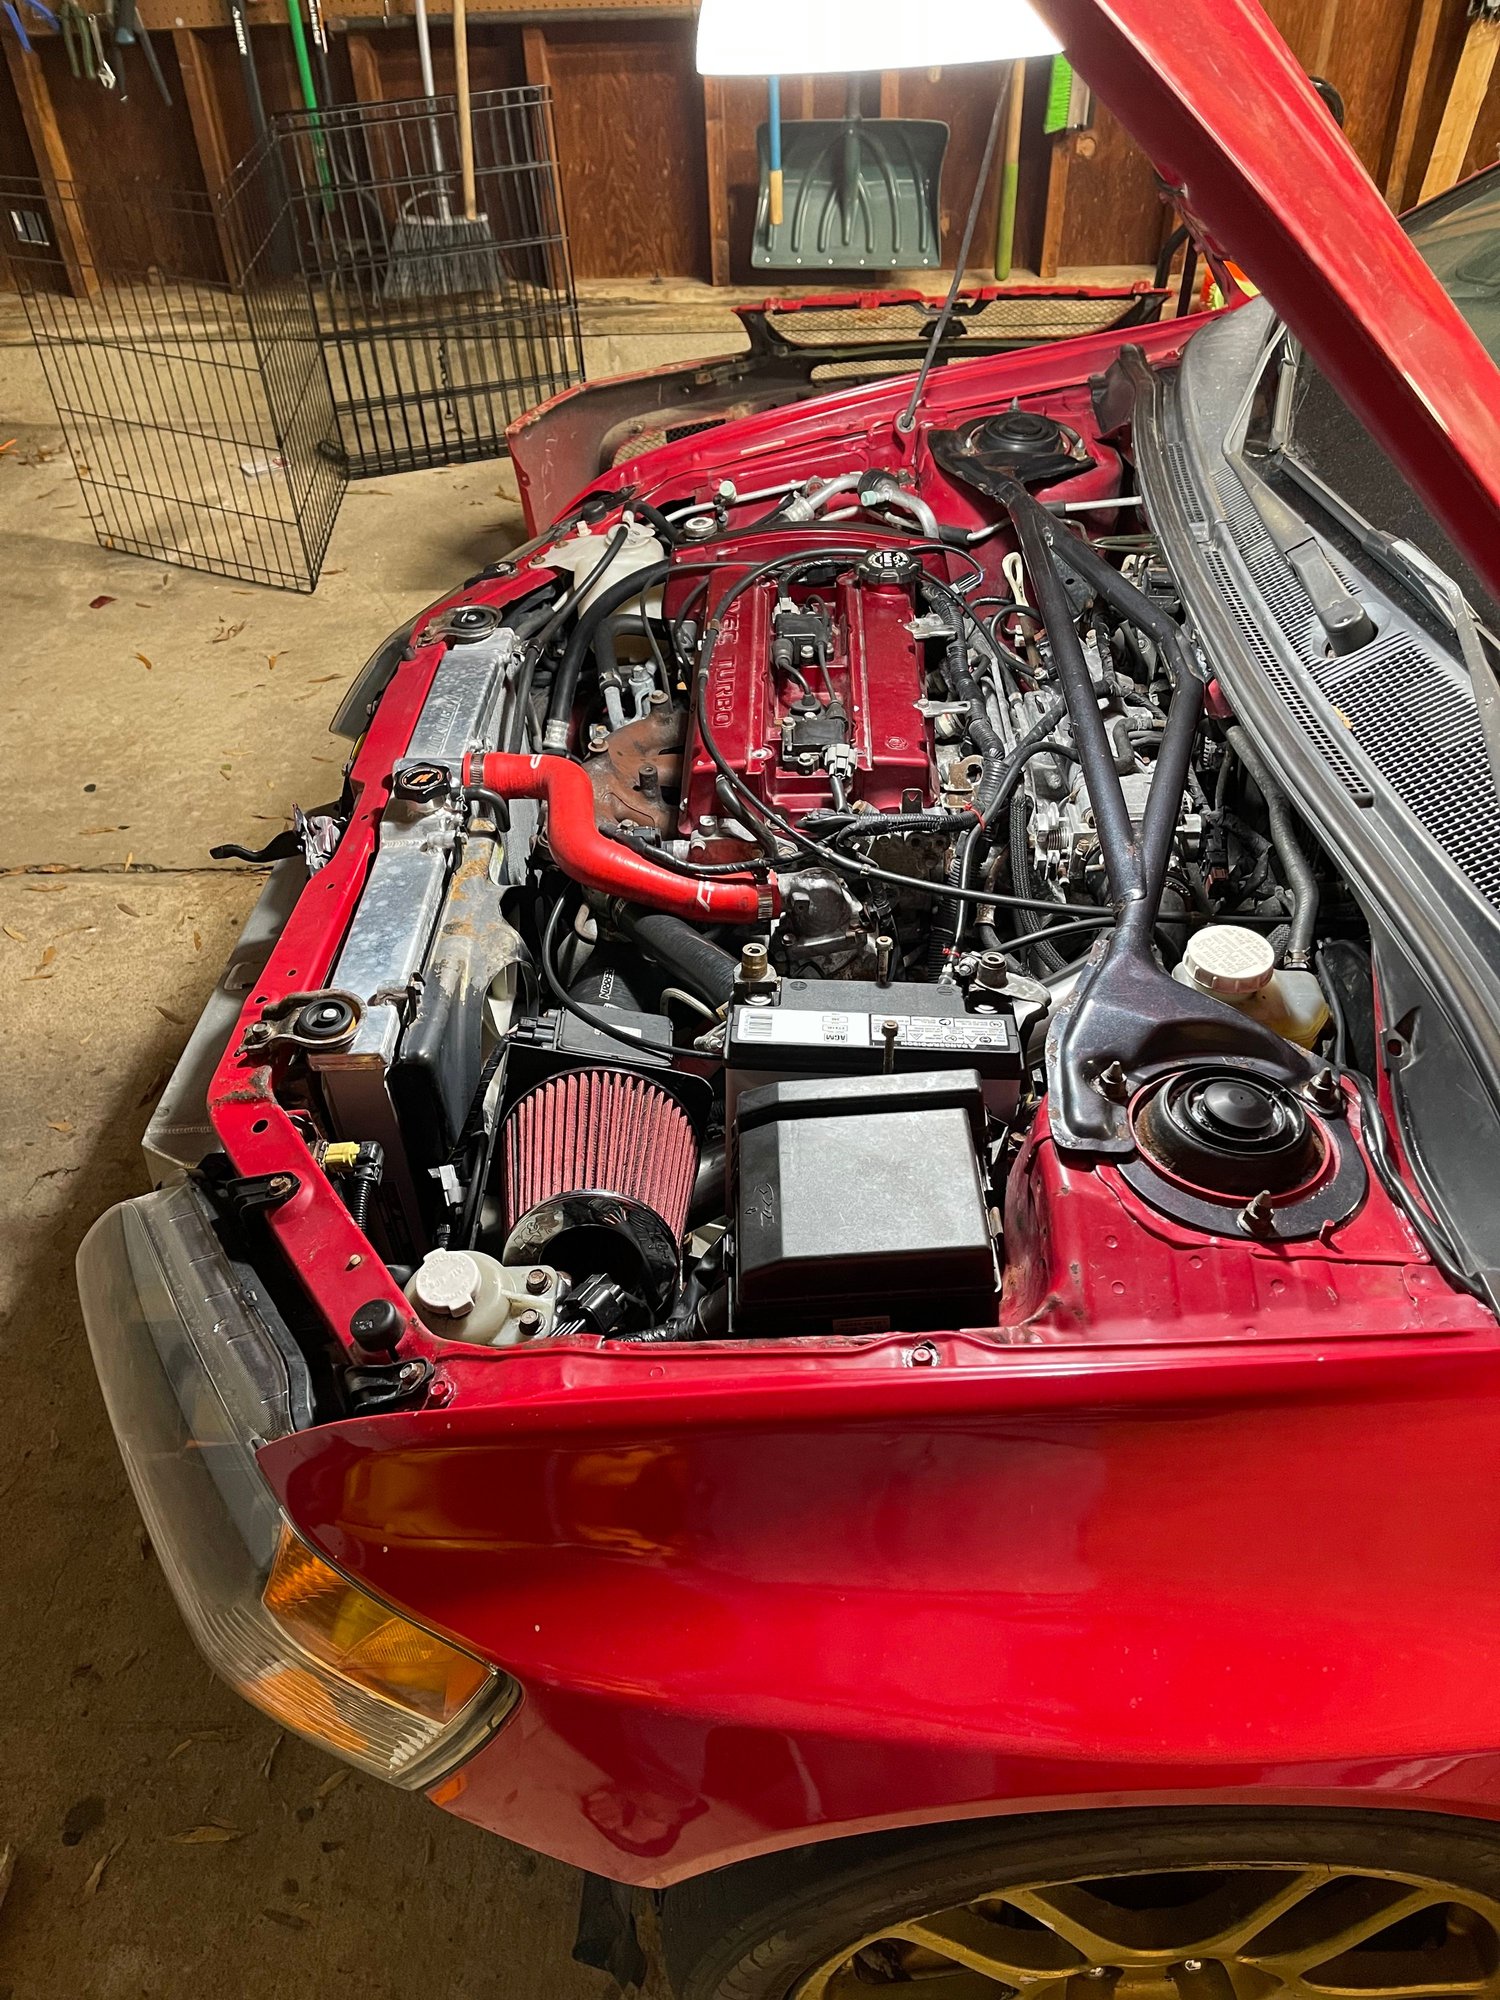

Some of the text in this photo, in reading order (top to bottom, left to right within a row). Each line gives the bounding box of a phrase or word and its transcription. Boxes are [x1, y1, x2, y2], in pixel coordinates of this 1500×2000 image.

[234, 19, 248, 56] HUSKY
[712, 655, 737, 728] TURBO
[599, 968, 615, 1000] PERRIN
